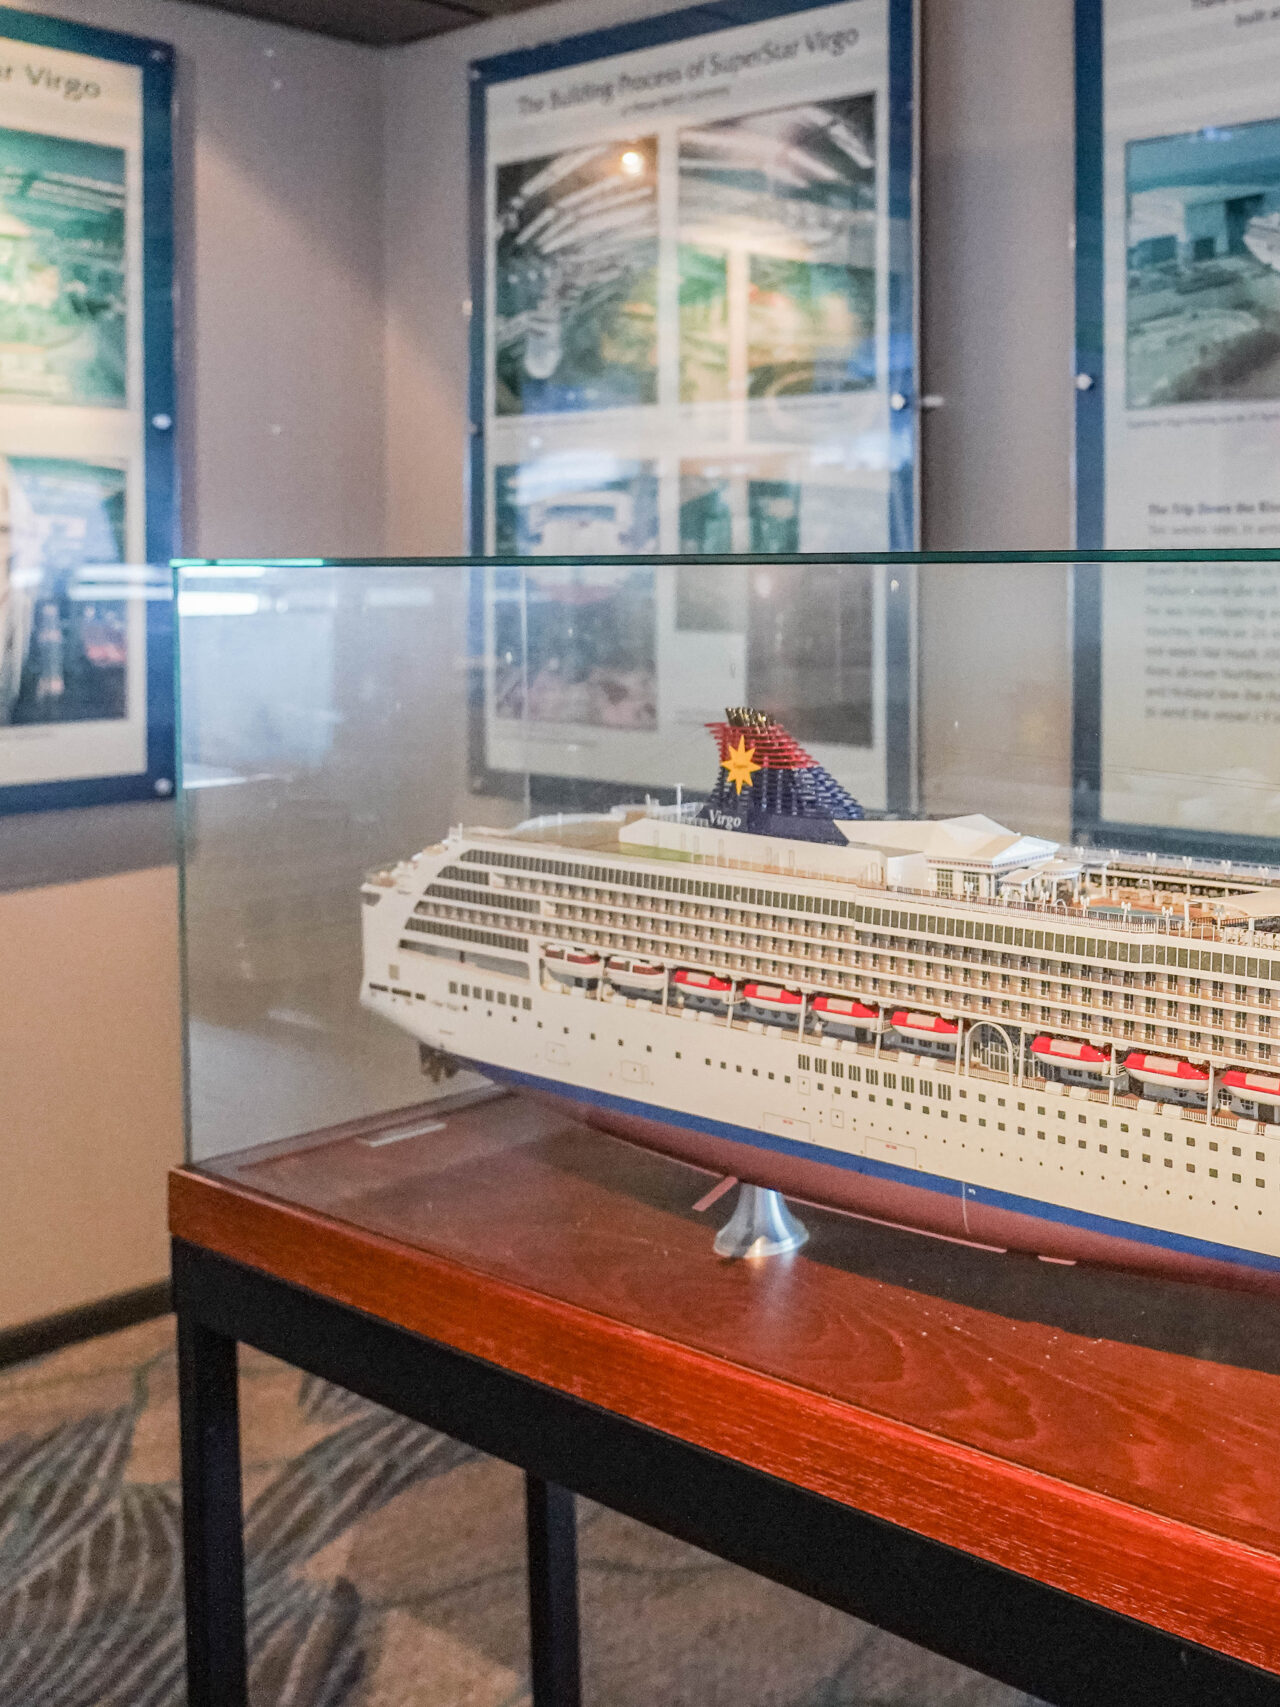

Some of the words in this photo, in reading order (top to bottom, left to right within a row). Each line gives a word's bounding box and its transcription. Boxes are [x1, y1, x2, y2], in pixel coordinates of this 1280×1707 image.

[686, 59, 706, 81] of
[804, 27, 861, 57] Virgo
[24, 63, 101, 102] Virgo
[709, 808, 742, 831] Virgo
